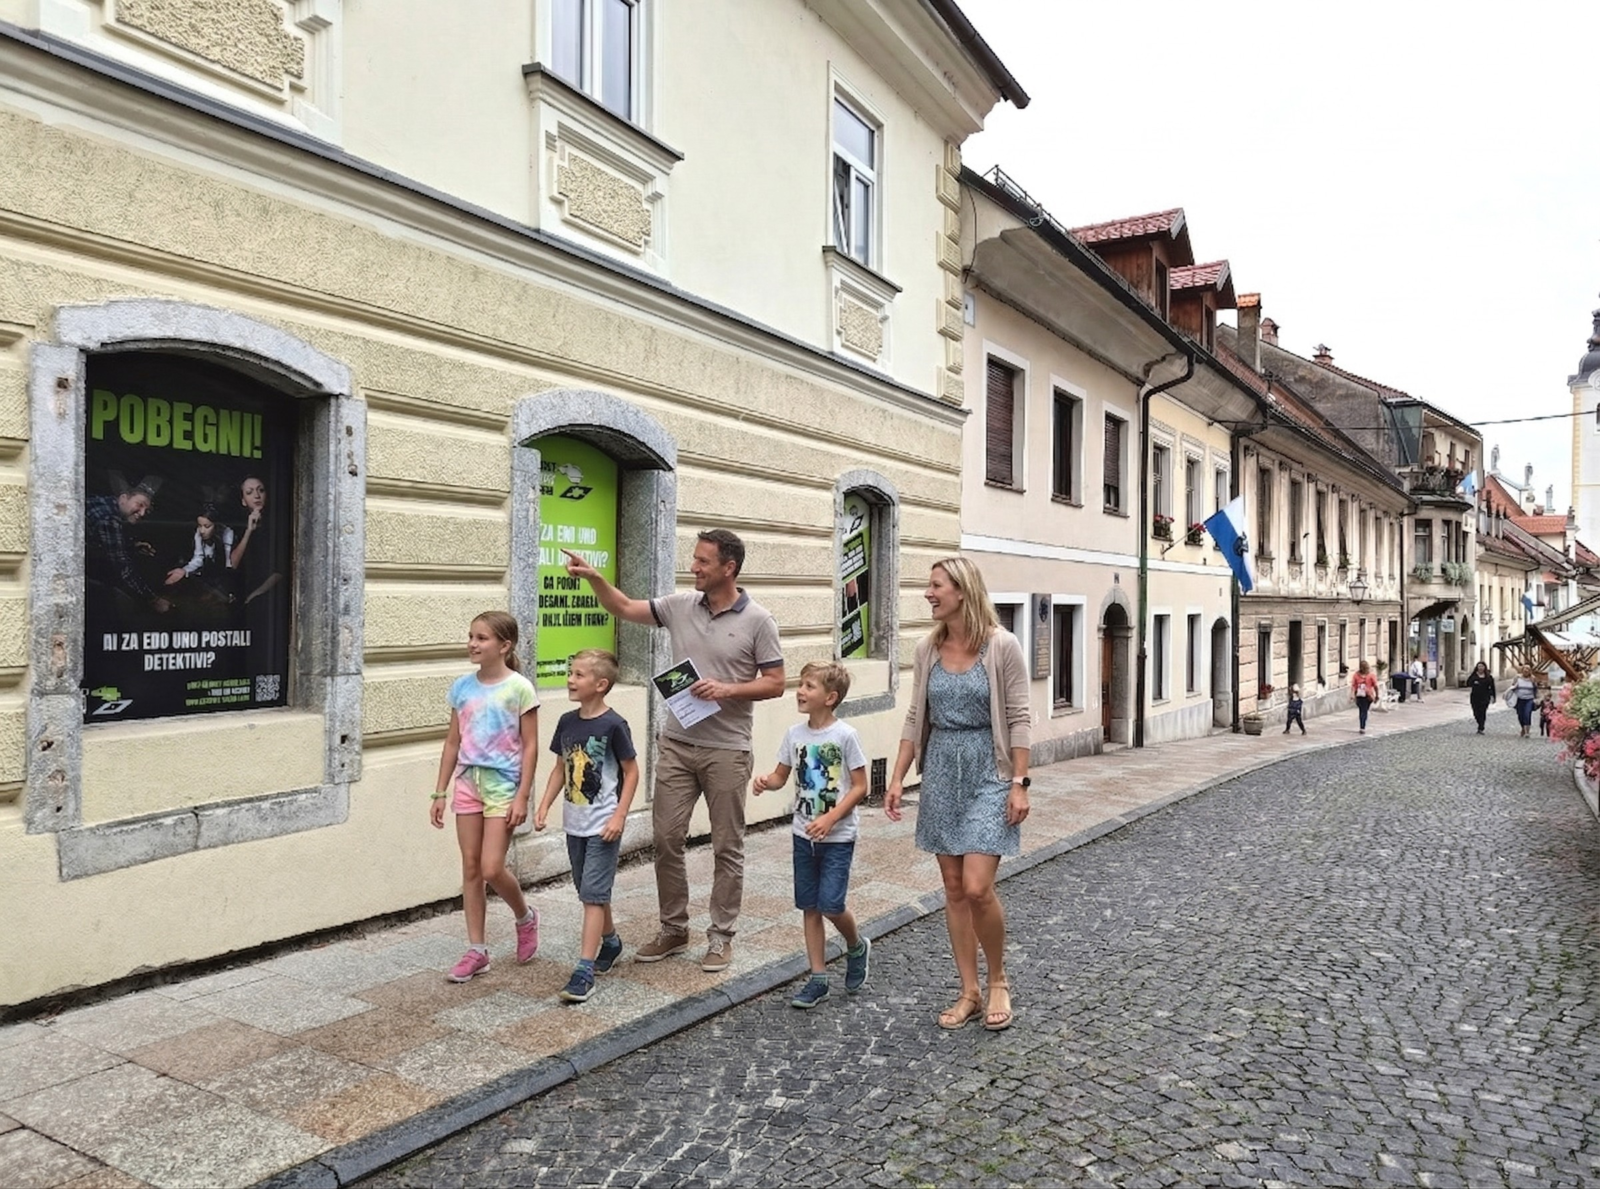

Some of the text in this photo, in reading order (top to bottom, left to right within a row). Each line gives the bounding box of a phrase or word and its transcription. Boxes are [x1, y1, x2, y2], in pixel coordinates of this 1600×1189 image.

[91, 389, 263, 459] POBEGNI!
[121, 633, 139, 650] ZA
[201, 630, 251, 648] POSTALI
[144, 651, 216, 672] DETEKTIVI?
